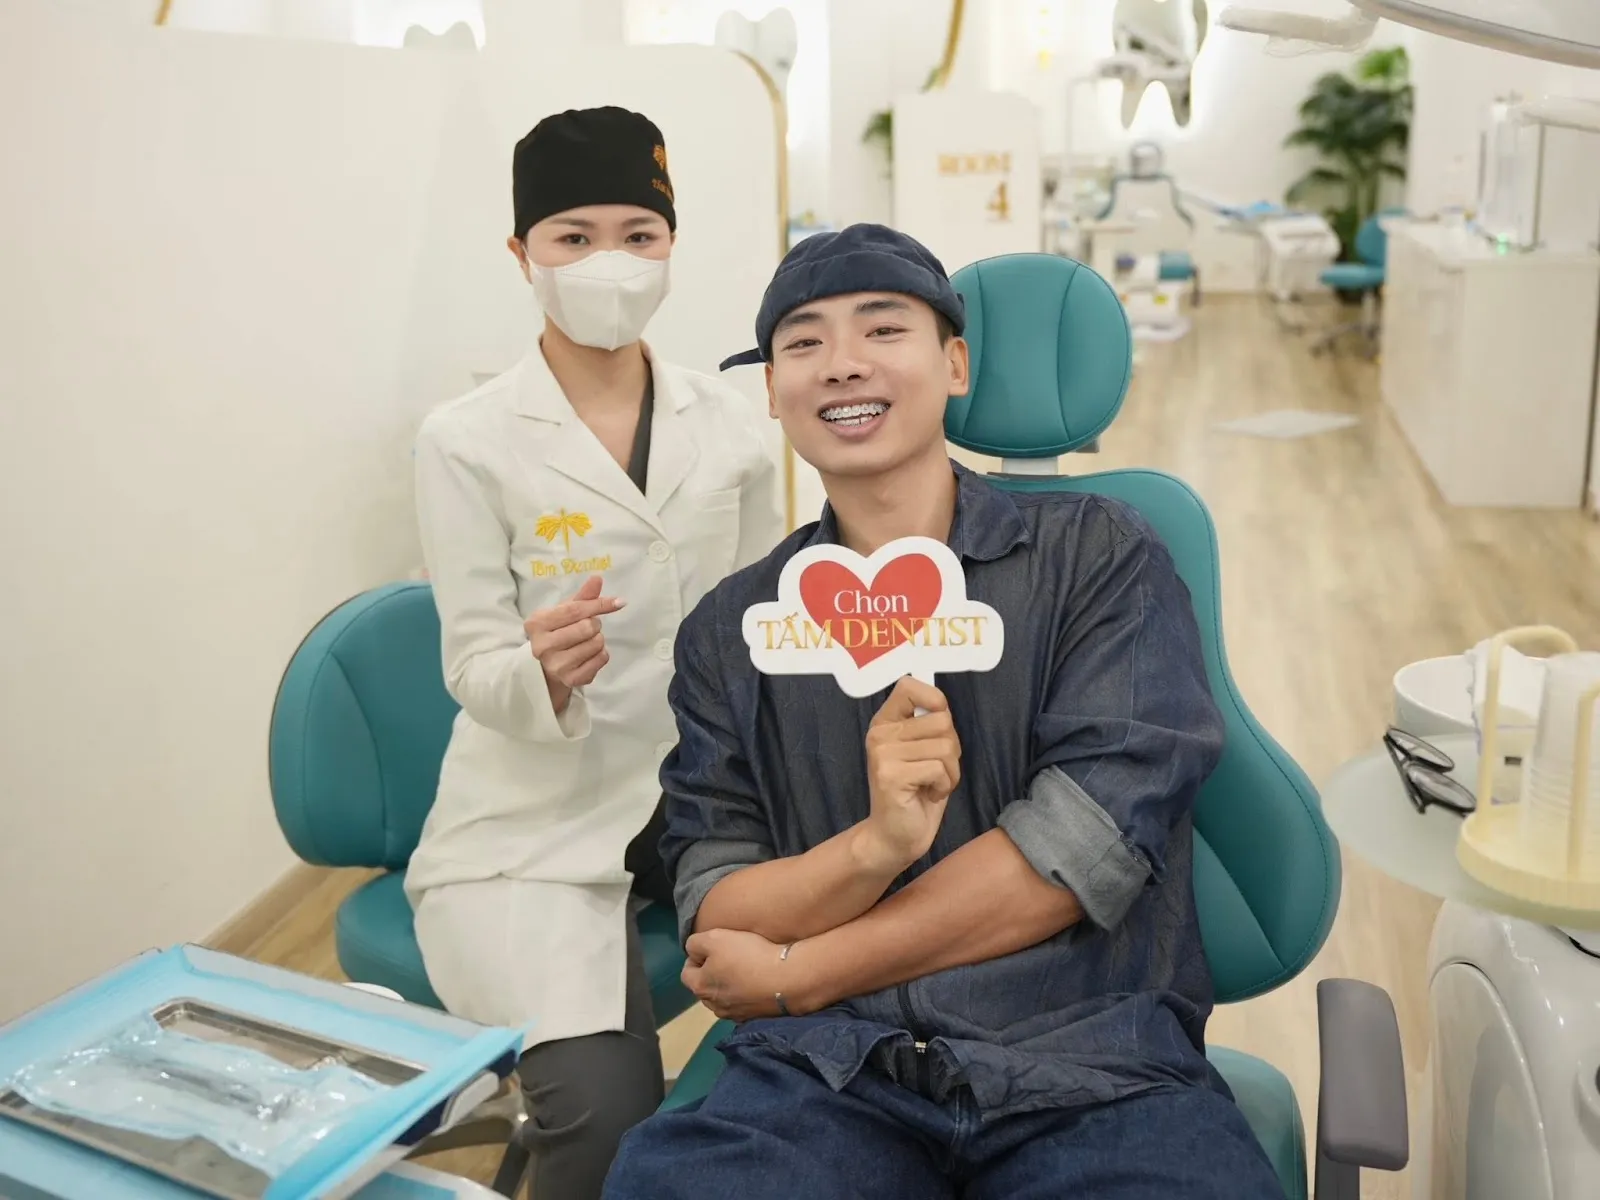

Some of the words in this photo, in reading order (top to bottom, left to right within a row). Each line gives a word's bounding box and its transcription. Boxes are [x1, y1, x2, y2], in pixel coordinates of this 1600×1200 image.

[985, 181, 1010, 221] 4
[833, 589, 909, 618] Chọn
[757, 611, 833, 650] TẤM
[842, 616, 989, 649] DENTIST
